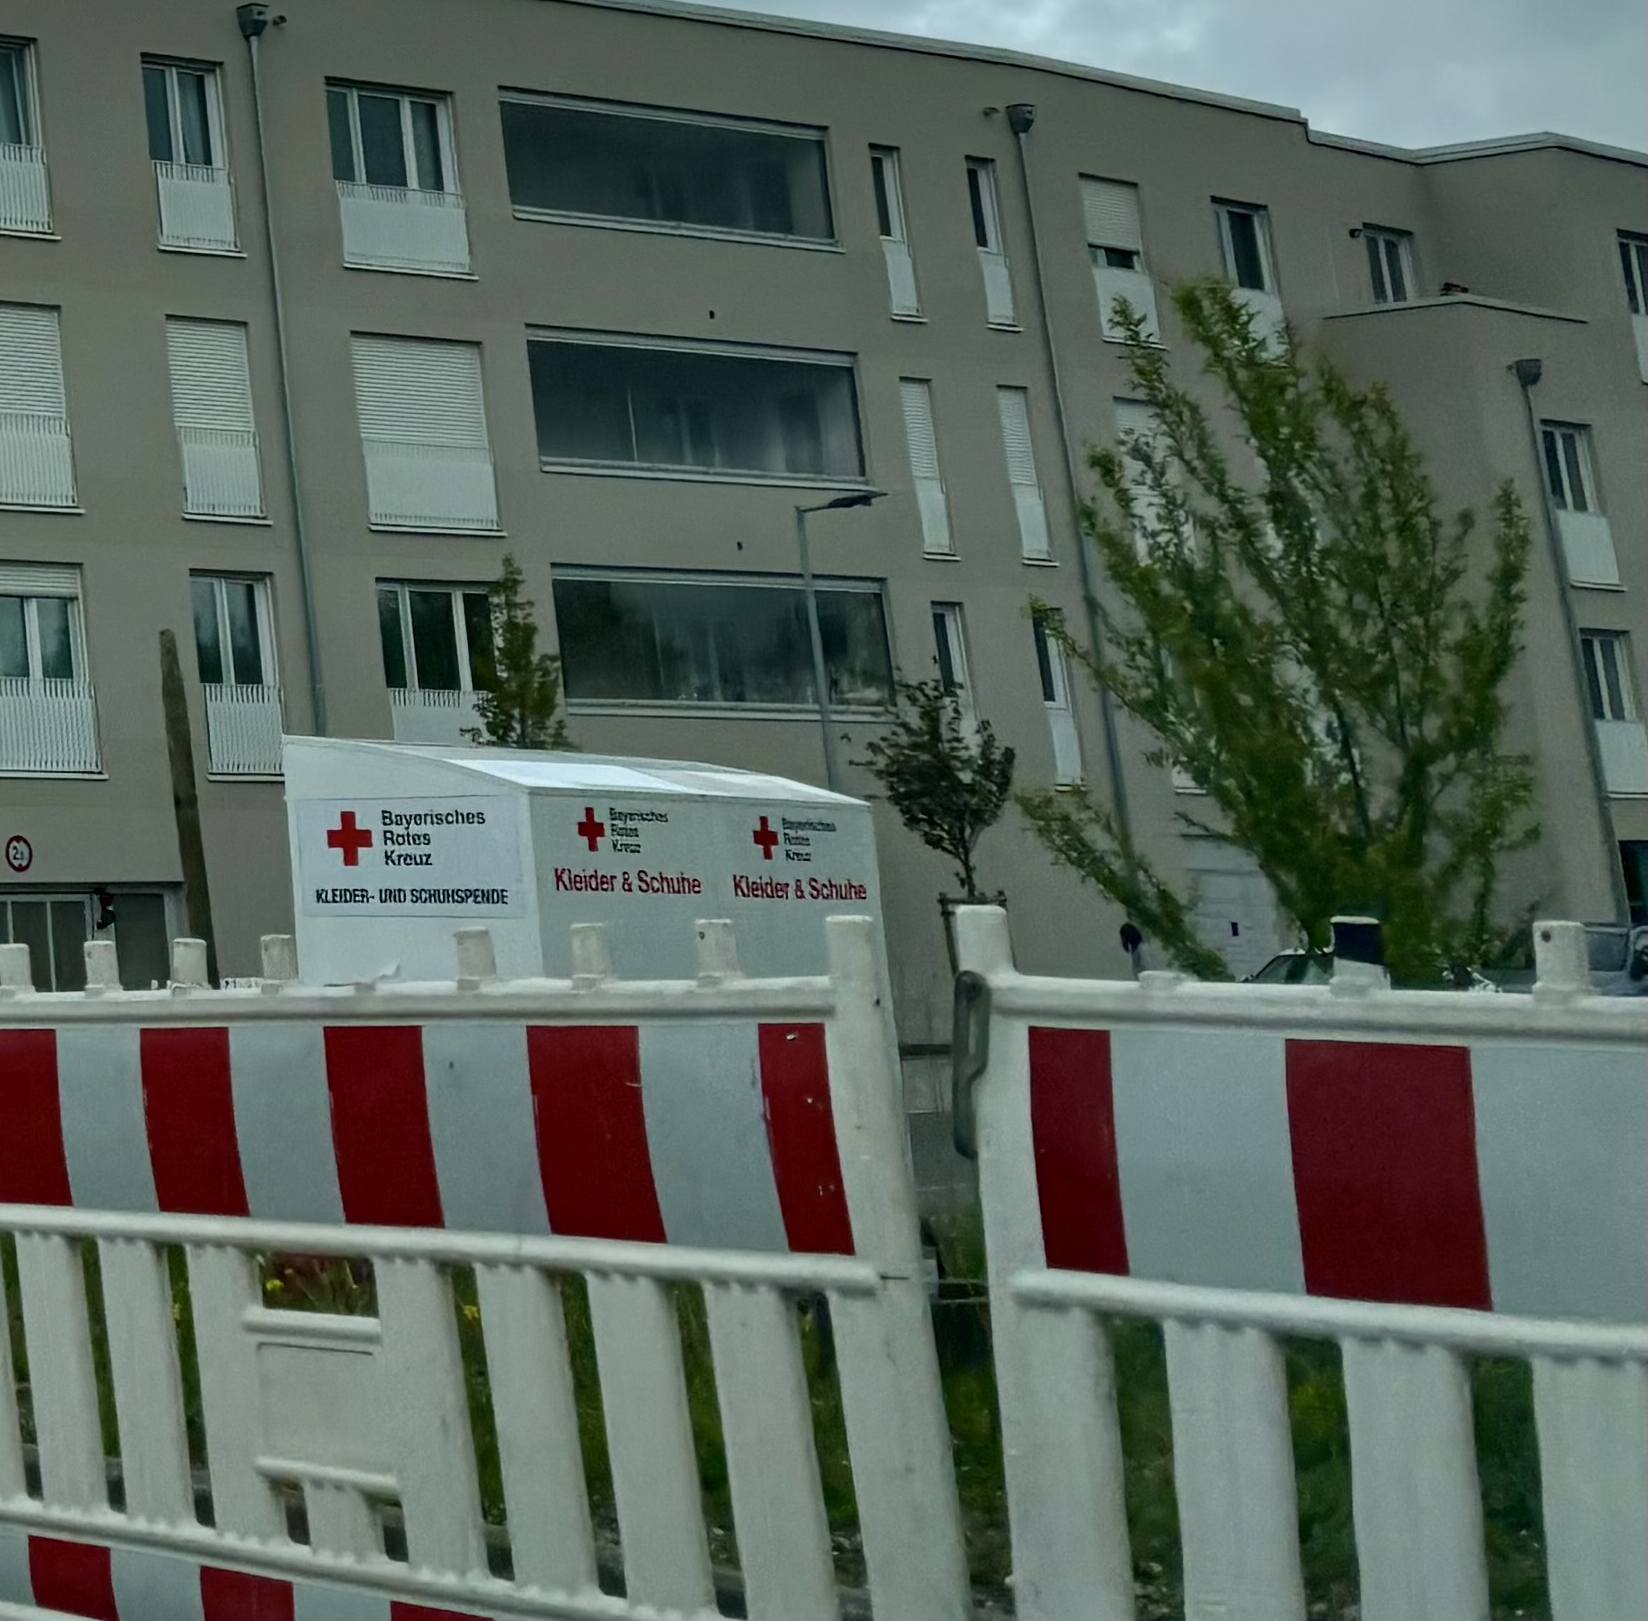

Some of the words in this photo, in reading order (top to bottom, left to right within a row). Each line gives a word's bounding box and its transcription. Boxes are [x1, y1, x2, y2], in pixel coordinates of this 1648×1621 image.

[381, 809, 486, 829] Bayerisches
[383, 830, 431, 846] Rotes
[384, 850, 433, 866] Kreuz
[554, 867, 617, 892] Kleider
[622, 871, 633, 893] &
[637, 870, 702, 895] Schuhe
[733, 874, 790, 900] Kleider
[795, 879, 806, 899] &
[808, 877, 867, 900] Schuhe
[316, 888, 375, 904] KLEIDER-
[379, 889, 406, 904] UND
[410, 888, 509, 905] SCHUHSPENDE
